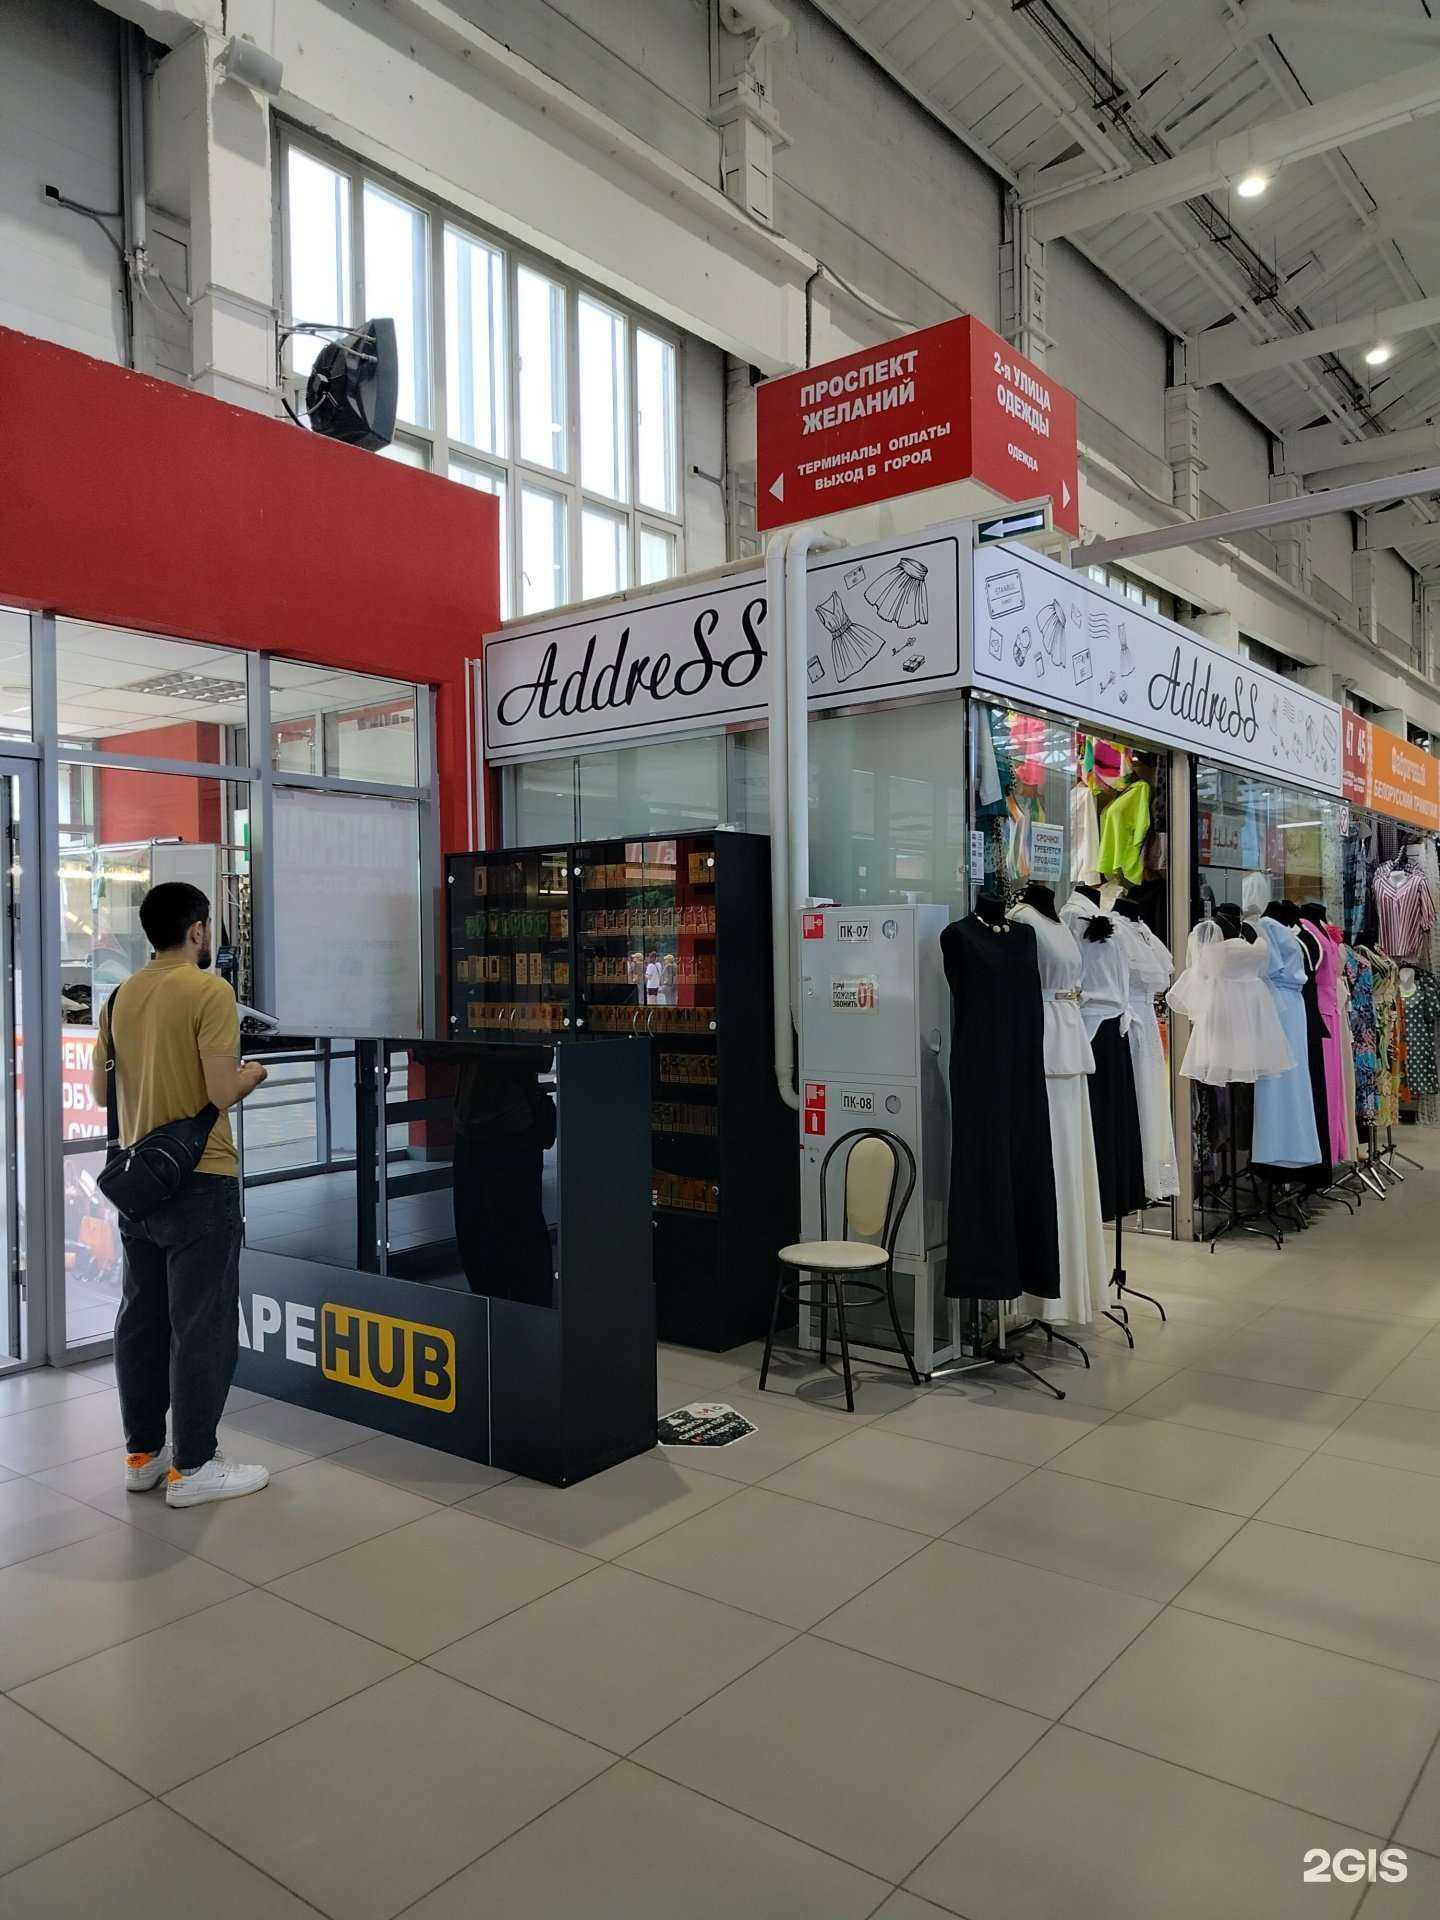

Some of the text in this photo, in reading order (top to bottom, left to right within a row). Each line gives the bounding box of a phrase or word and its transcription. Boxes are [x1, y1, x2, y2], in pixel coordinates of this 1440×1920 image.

[800, 350, 919, 407] ПРОСПЕКТ
[993, 351, 1052, 412] 2-я УЛИЦА
[802, 378, 916, 436] ЖЕЛАНИЙ
[997, 385, 1050, 438] ОДЕЖДЫ
[797, 422, 951, 477] ТЕРМИНАЛЫ ОПЛАТЫ
[815, 448, 932, 491] ВЫХОД В ГОРОД
[1007, 442, 1039, 472] ОДЕЖДА
[839, 925, 868, 938] ПК-07
[833, 1000, 858, 1008] ЗВОНИТЬ
[843, 1095, 872, 1110] ПК-08
